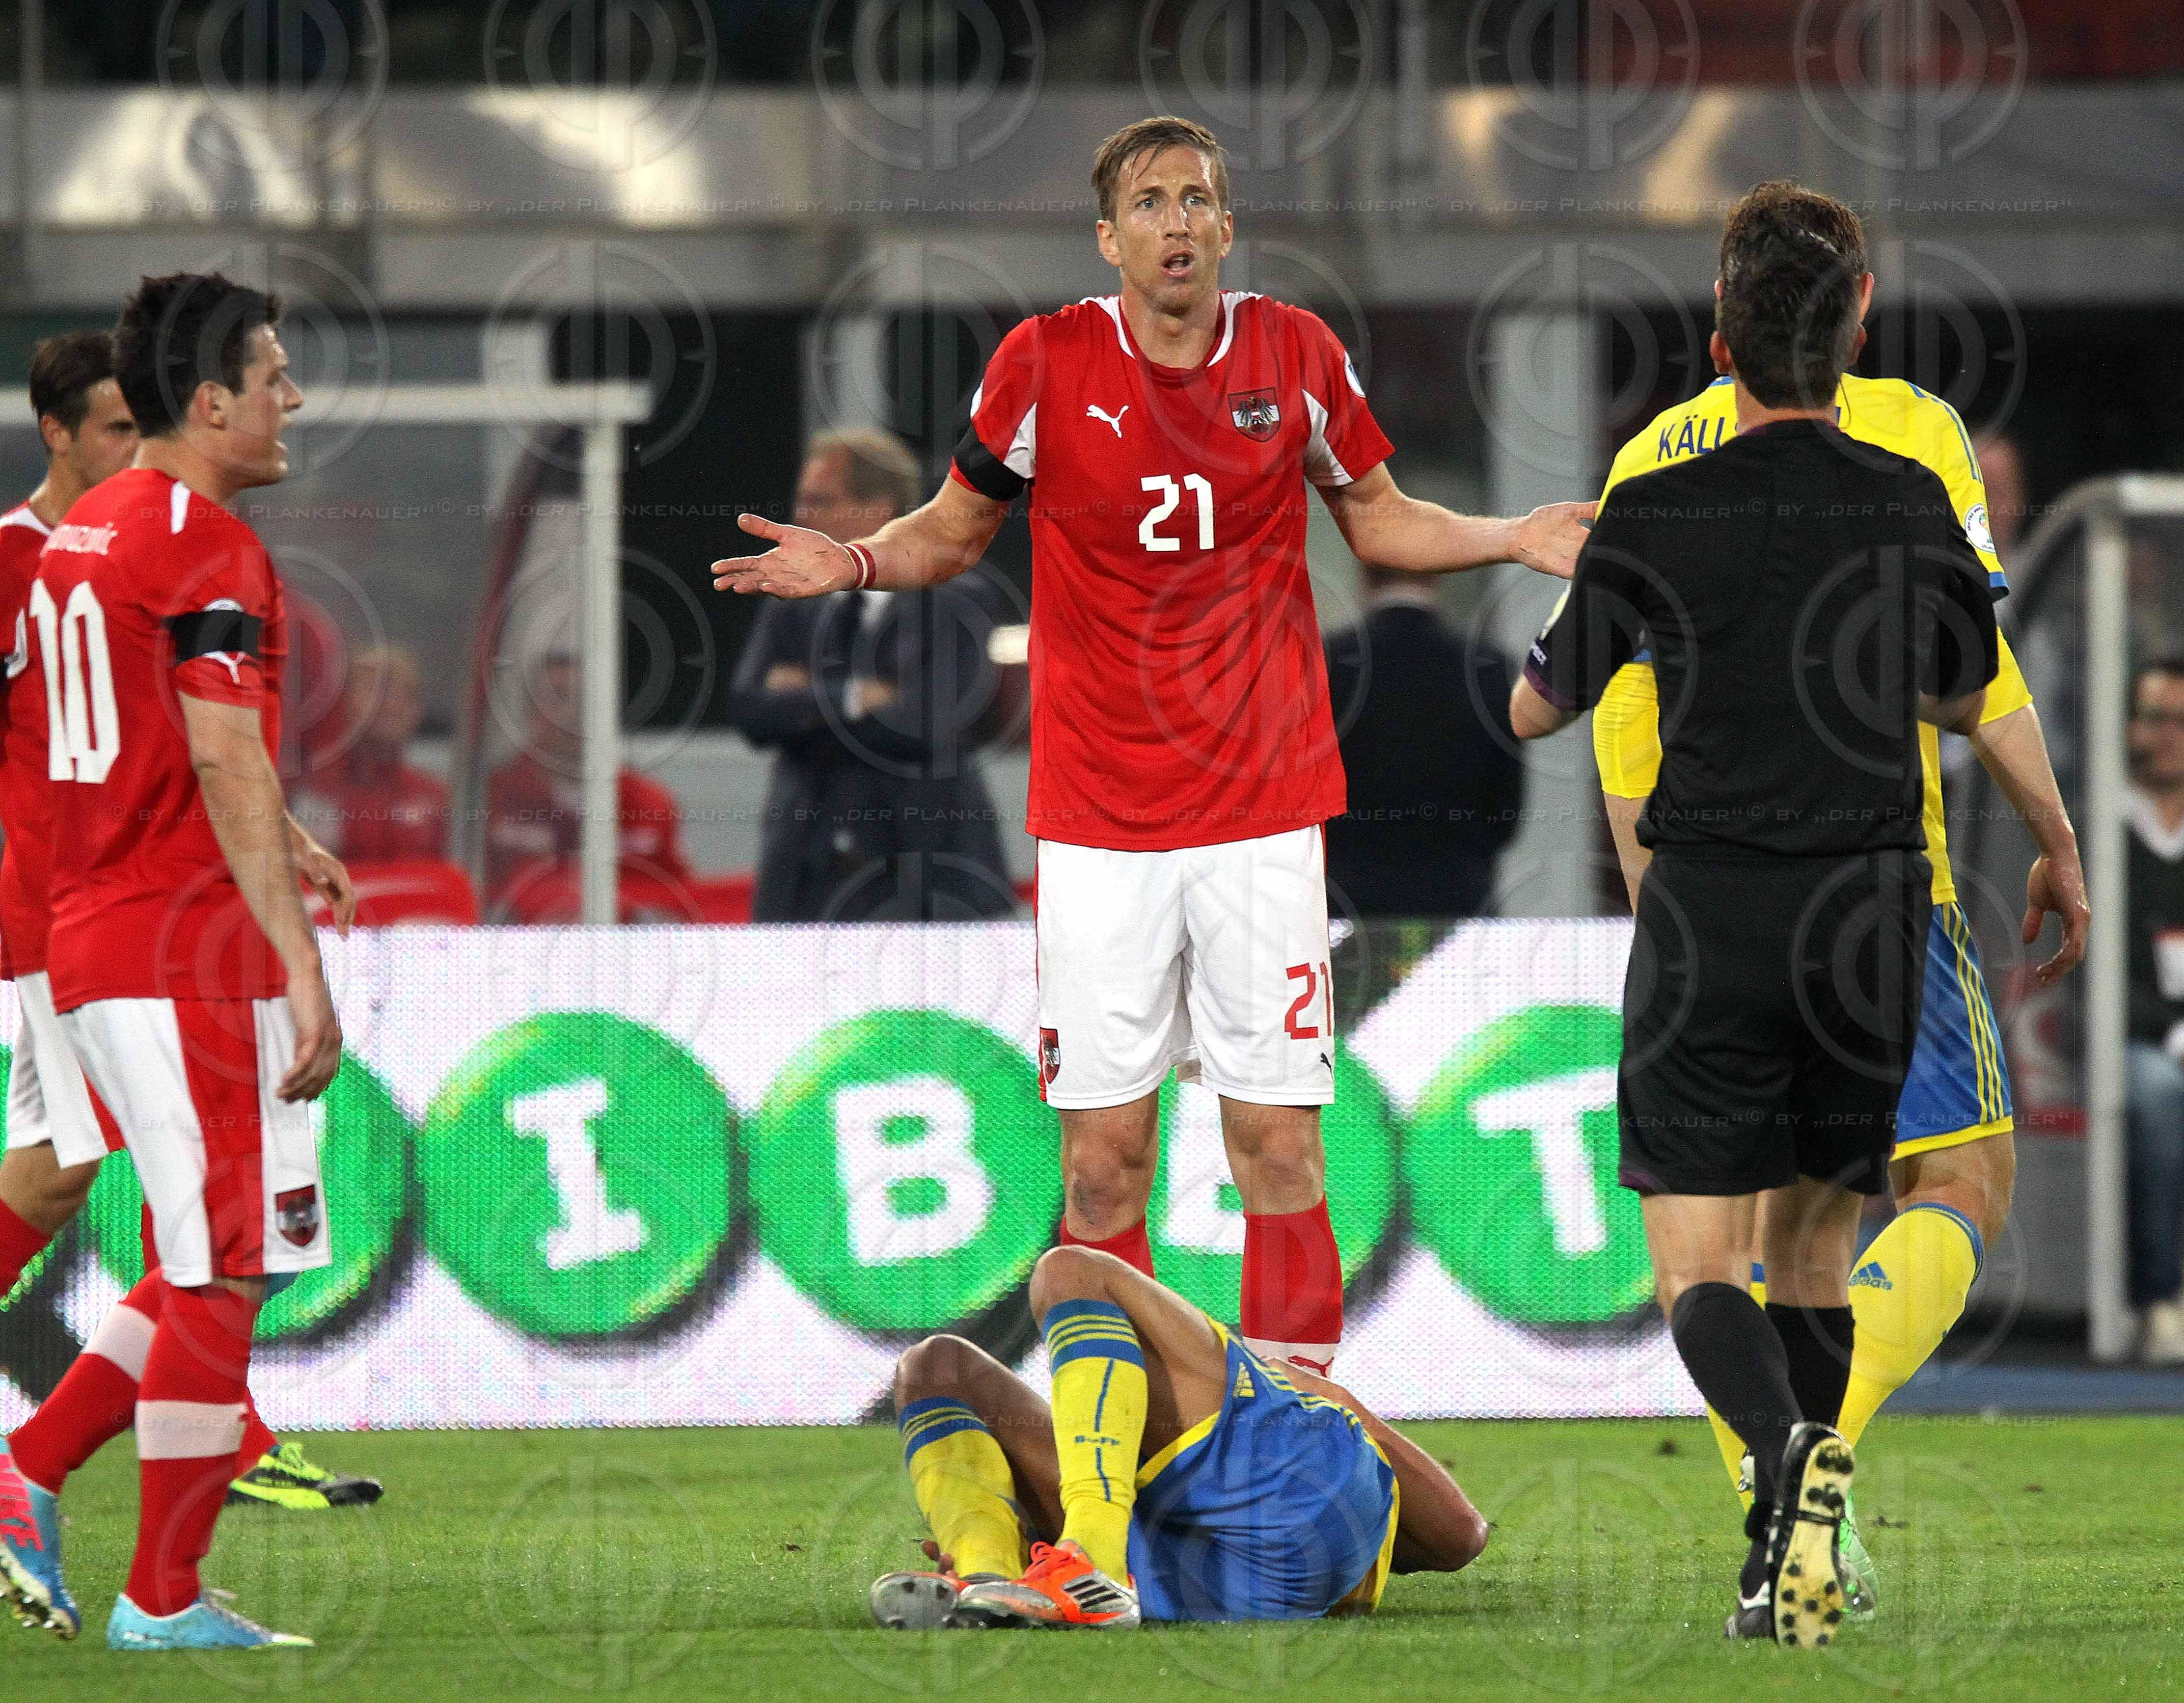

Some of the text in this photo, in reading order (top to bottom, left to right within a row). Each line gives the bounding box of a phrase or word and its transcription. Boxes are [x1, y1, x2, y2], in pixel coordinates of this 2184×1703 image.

[1657, 414, 1738, 462] KÄLL
[1139, 474, 1214, 551] 21
[30, 579, 119, 783] 10
